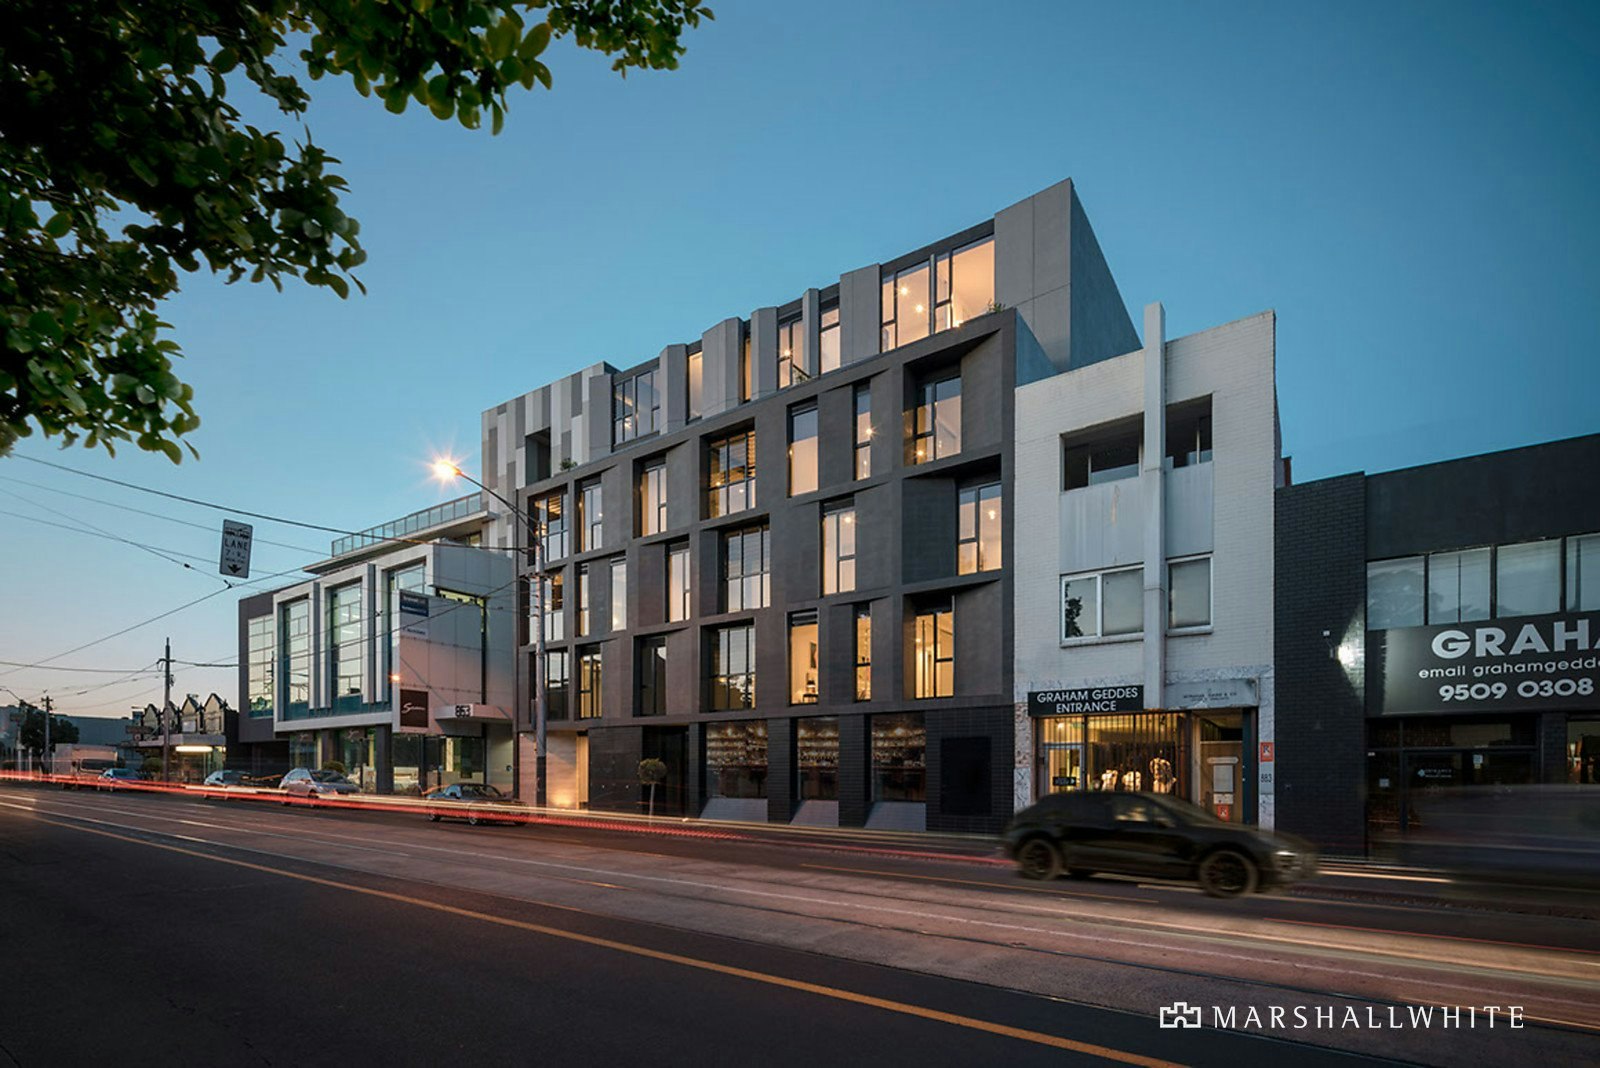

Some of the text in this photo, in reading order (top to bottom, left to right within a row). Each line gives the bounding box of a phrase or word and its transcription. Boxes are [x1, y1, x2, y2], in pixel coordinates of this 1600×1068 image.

[224, 538, 248, 551] LANE
[1431, 619, 1600, 660] GRAH
[1418, 665, 1466, 679] email
[1037, 687, 1138, 703] GRAHAM GEDDES
[1438, 678, 1594, 702] 9509 0308
[1056, 701, 1117, 714] ENTRANCE
